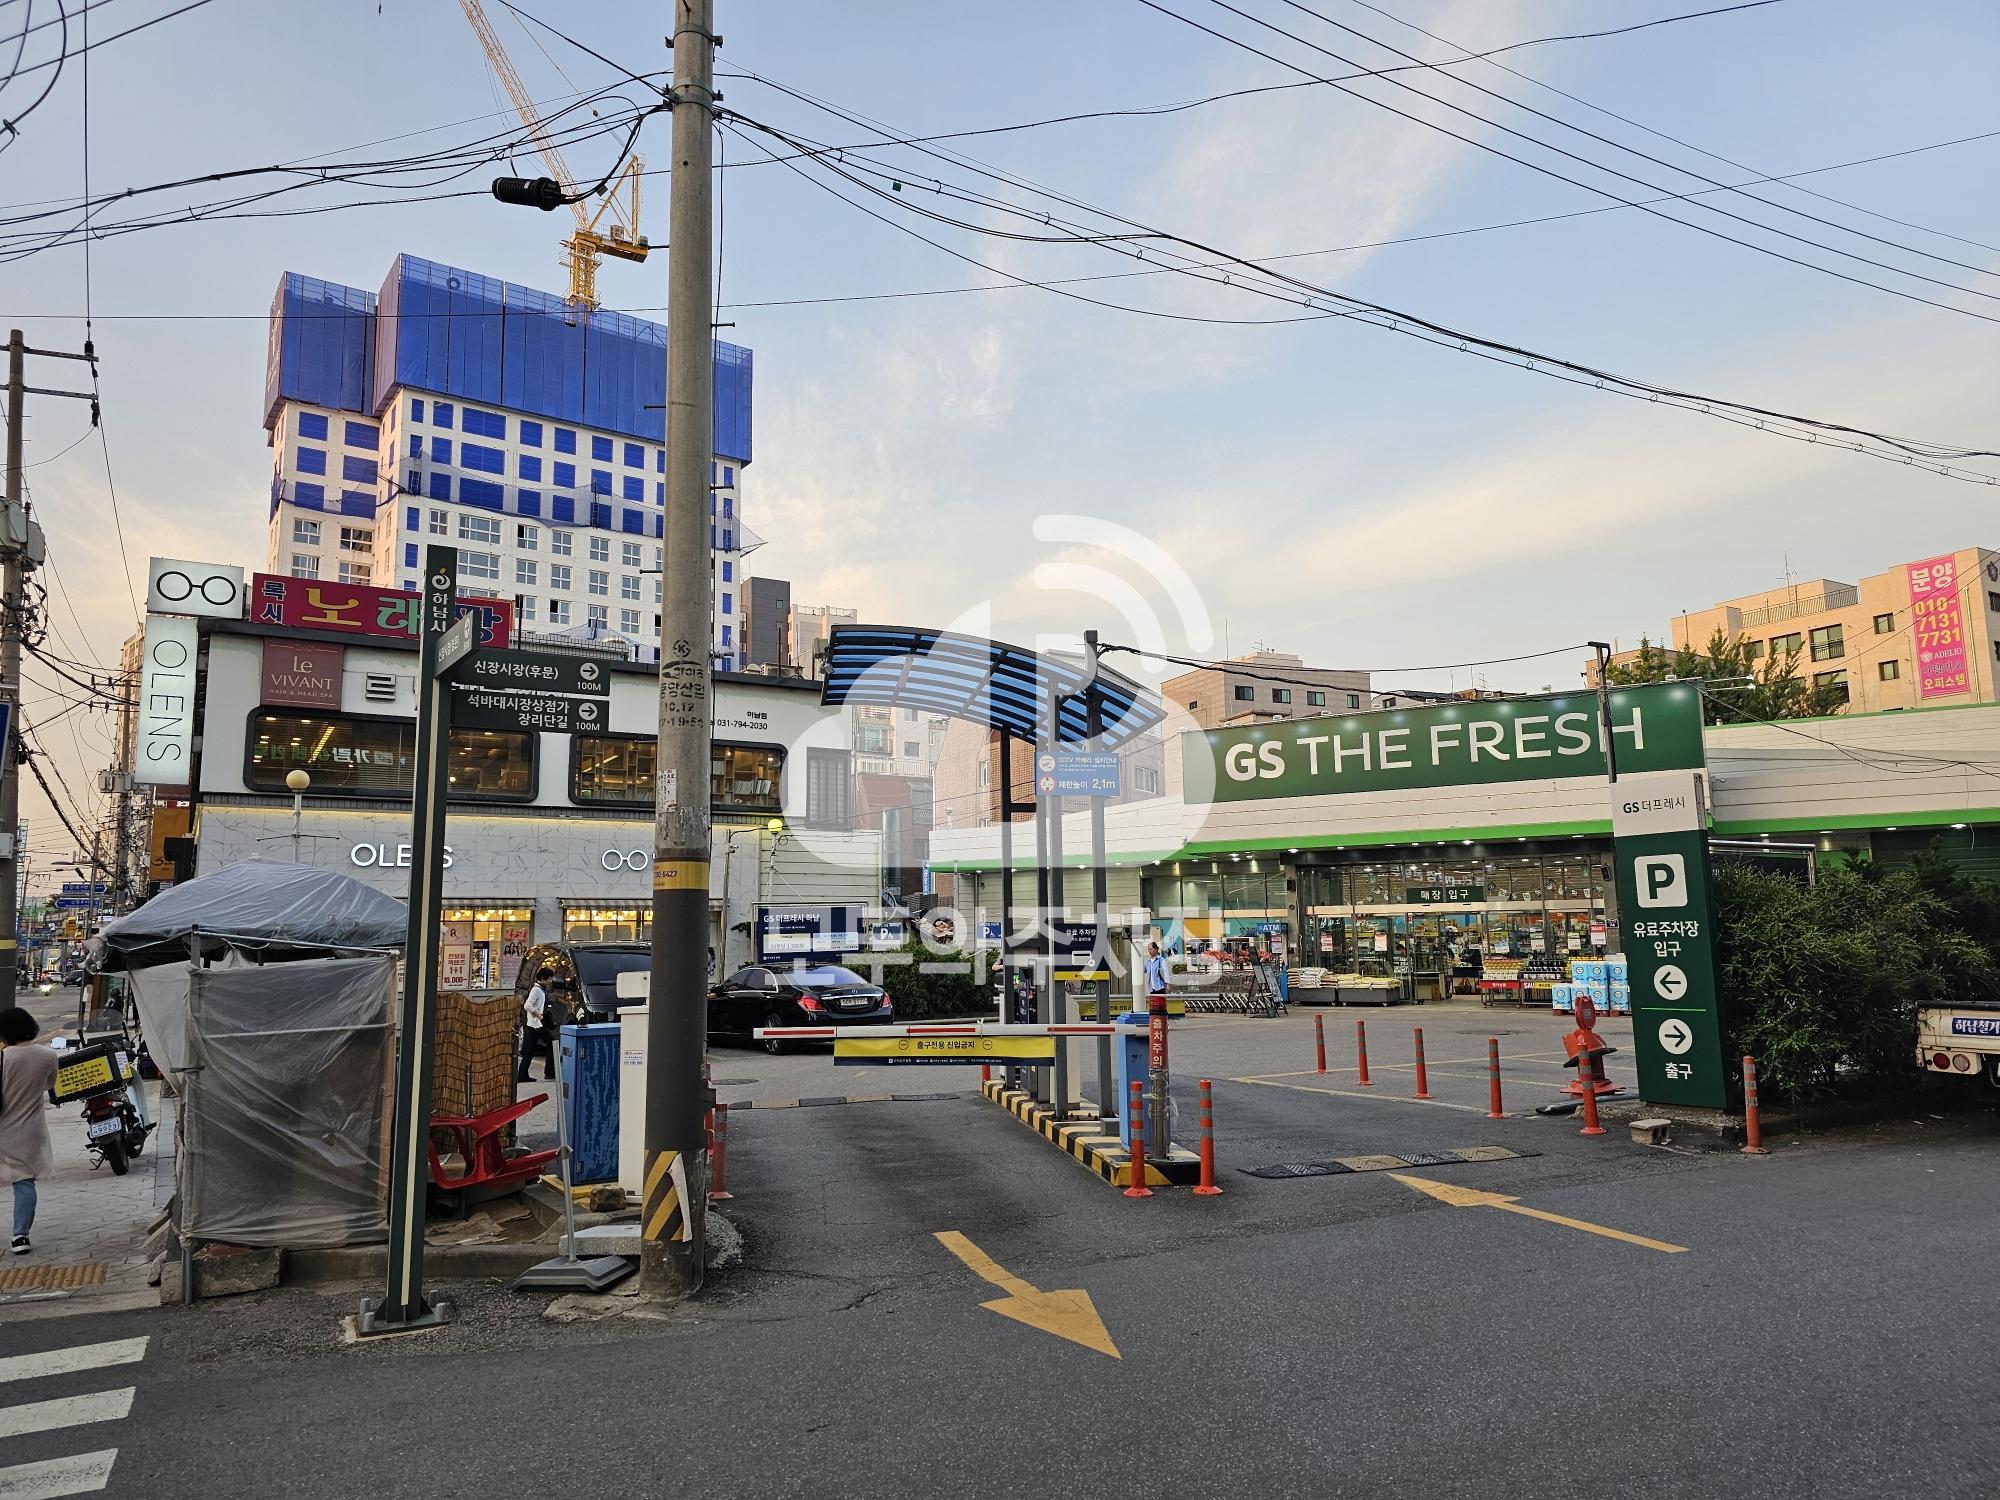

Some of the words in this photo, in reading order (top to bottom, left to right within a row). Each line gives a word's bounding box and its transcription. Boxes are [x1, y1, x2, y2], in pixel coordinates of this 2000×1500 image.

[1911, 563, 1953, 593] 분양
[431, 592, 449, 633] 하남시
[1915, 597, 1956, 616] 010-
[1917, 610, 1959, 632] 7131
[1918, 627, 1961, 648] 7731
[1934, 648, 1963, 660] ADELIO
[293, 655, 313, 674] Le
[271, 673, 334, 690] VIVANT
[474, 660, 559, 681] 신장시장(후문)
[577, 682, 601, 691] 100M
[1924, 673, 1966, 690] 오피스텔
[146, 639, 188, 761] OLENS
[467, 694, 570, 715] 석바대시장상점가
[518, 713, 569, 729] 장리단길
[576, 722, 601, 732] 100M
[717, 719, 768, 731] 031-794-2030
[1225, 740, 1285, 782] GS
[1297, 728, 1412, 776] THE
[1430, 707, 1645, 767] FRESH
[1092, 778, 1116, 790] 2.1m
[1623, 802, 1639, 813] GS
[1642, 797, 1685, 812] 더프레시
[351, 843, 453, 868] OLES
[1647, 863, 1675, 899] P
[1420, 890, 1441, 900] 매장
[1448, 889, 1469, 900] 입구
[763, 915, 775, 923] GS
[776, 913, 805, 923] 더프레시
[1078, 928, 1097, 936] 주차장
[1262, 923, 1280, 932] ATM
[1633, 921, 1699, 938] 유료주차장
[1654, 941, 1682, 958] 입구
[917, 1040, 945, 1050] 출구전용
[947, 1040, 975, 1050] 진입금지
[1153, 1018, 1163, 1067] 출차주의
[1665, 1062, 1693, 1080] 출구
